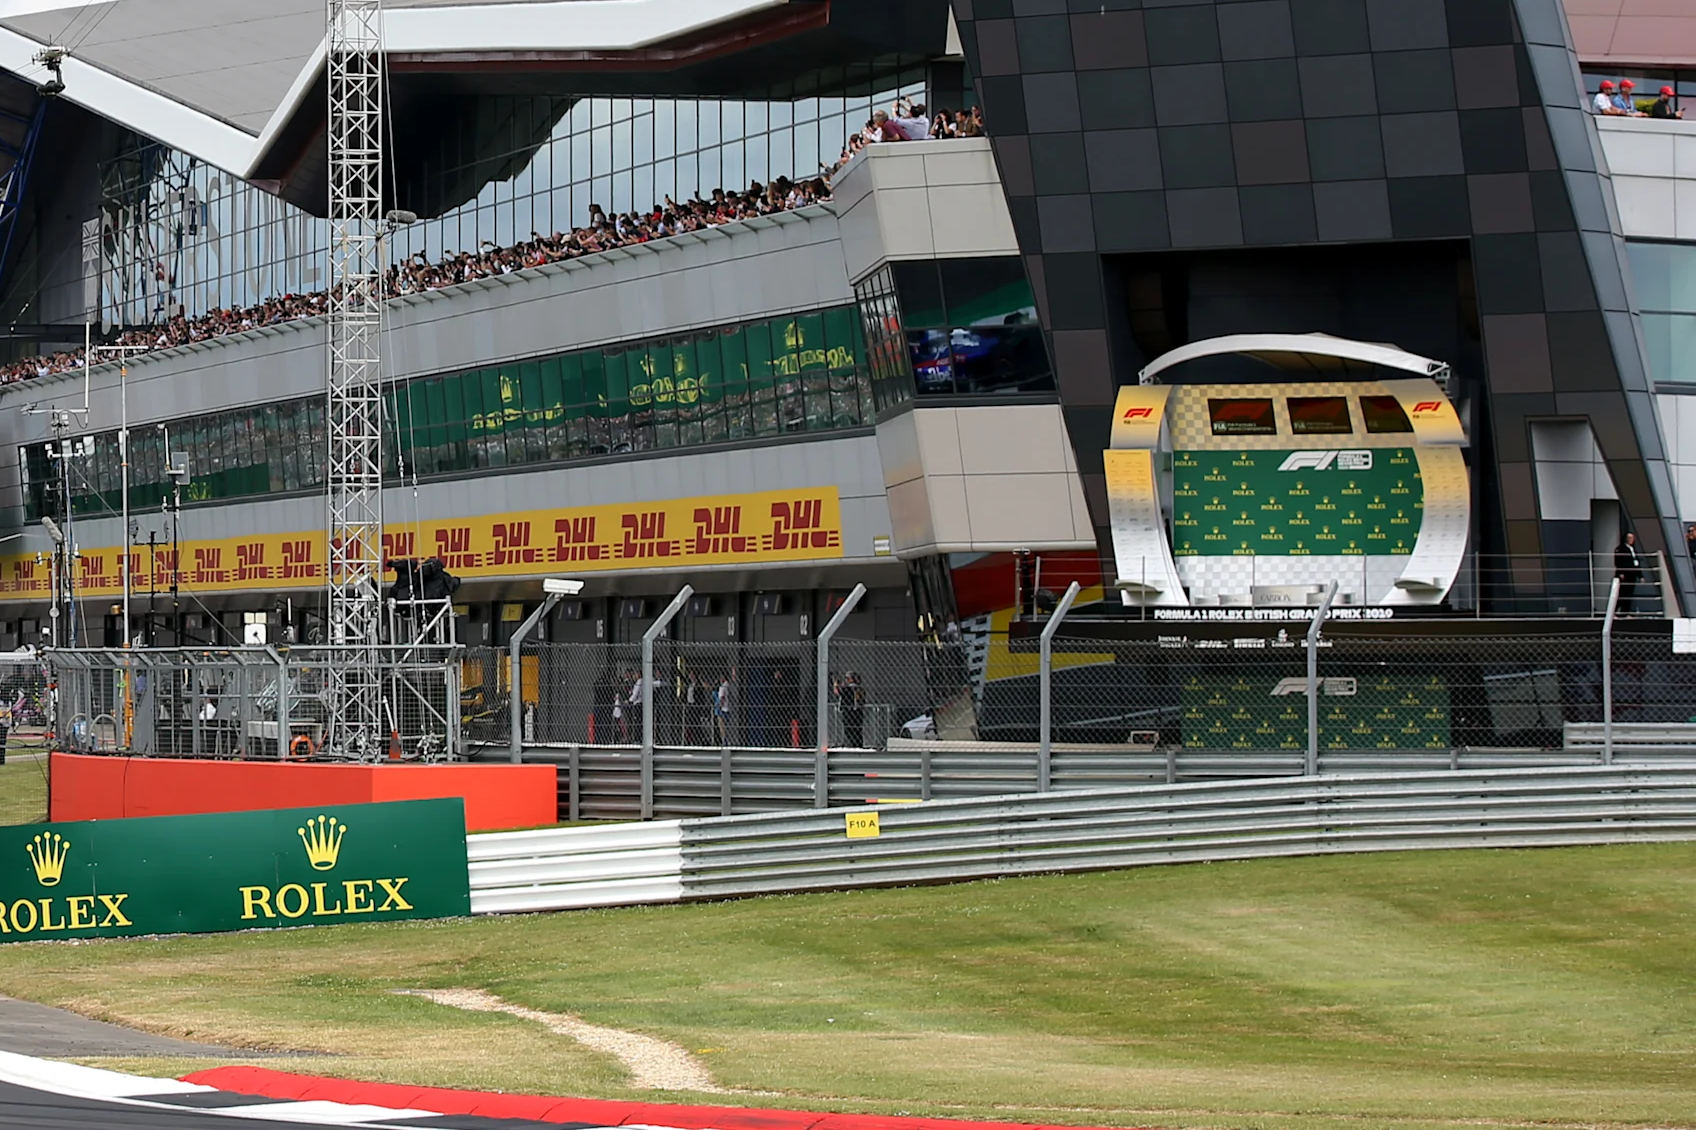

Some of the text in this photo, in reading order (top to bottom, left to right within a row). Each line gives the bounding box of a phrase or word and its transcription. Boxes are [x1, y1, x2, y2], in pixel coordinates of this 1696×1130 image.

[554, 517, 601, 562] DHL
[621, 511, 671, 558] DHL
[693, 506, 747, 553] DHL
[770, 499, 827, 549] DHL
[237, 543, 268, 580] DHL
[282, 541, 316, 578] DHL
[436, 528, 475, 569] DHL
[492, 522, 534, 565] DHL
[14, 560, 37, 591] DHL
[81, 556, 105, 588] DHL
[156, 550, 183, 584] DHL
[195, 548, 224, 582] DHL
[800, 614, 808, 636] 02
[1154, 609, 1201, 619] FORMULA
[1209, 610, 1244, 619] ROLEX
[1245, 610, 1288, 619] BRITISH
[1332, 609, 1361, 618] PRIX
[849, 820, 866, 828] F10
[240, 877, 413, 920] ROLEX
